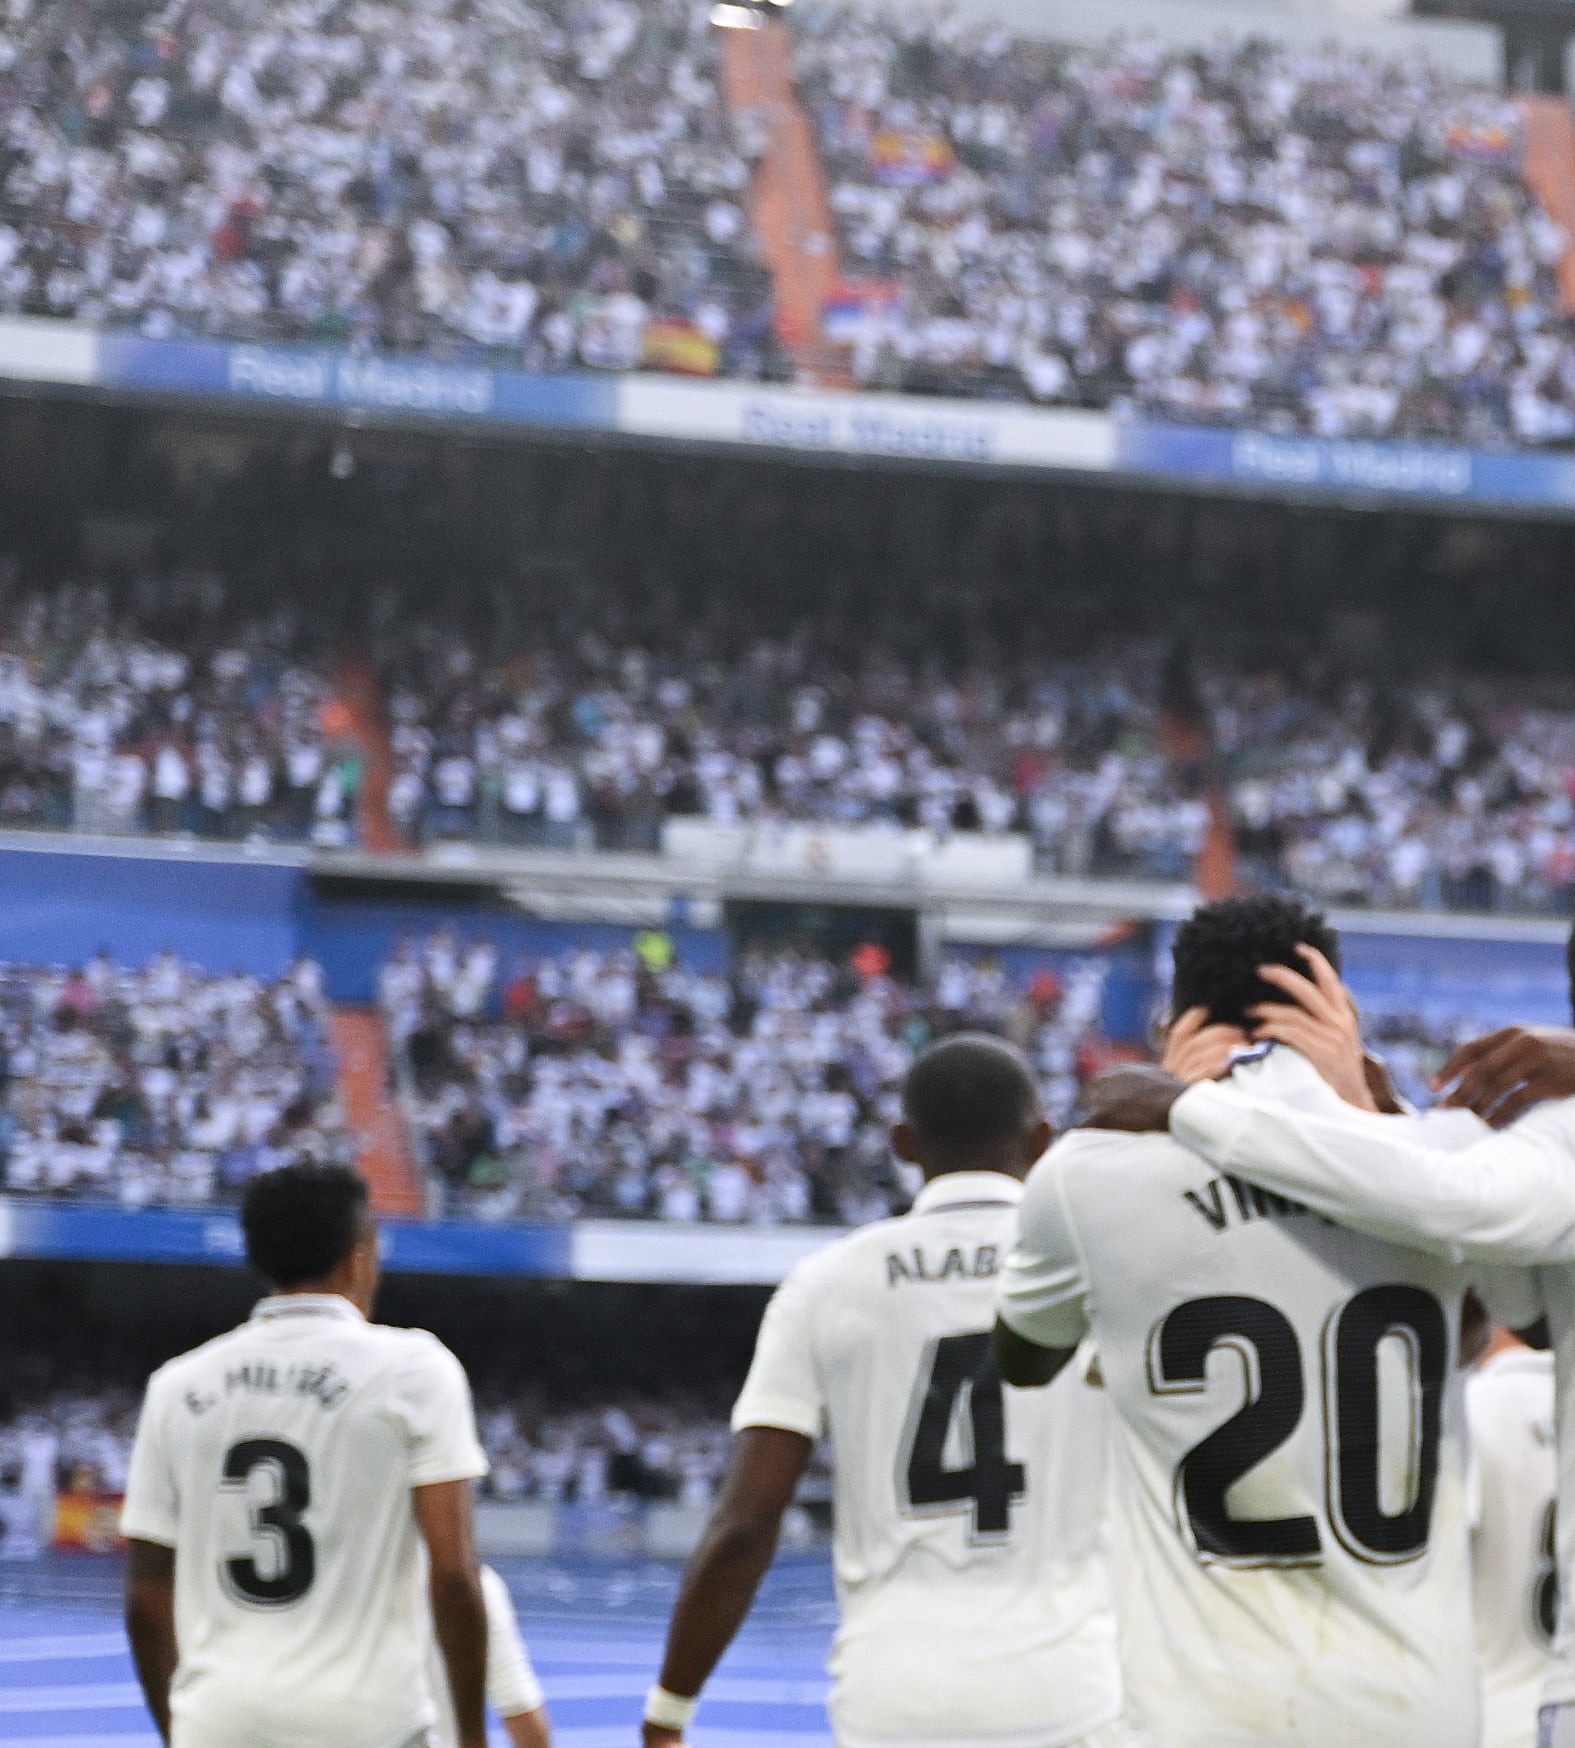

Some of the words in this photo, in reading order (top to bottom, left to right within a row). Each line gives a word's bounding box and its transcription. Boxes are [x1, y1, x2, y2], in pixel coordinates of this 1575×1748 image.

[886, 1243, 1000, 1290] ALAB
[219, 1437, 316, 1606] 3
[902, 1332, 1027, 1548] 4
[1147, 1283, 1449, 1568] 20
